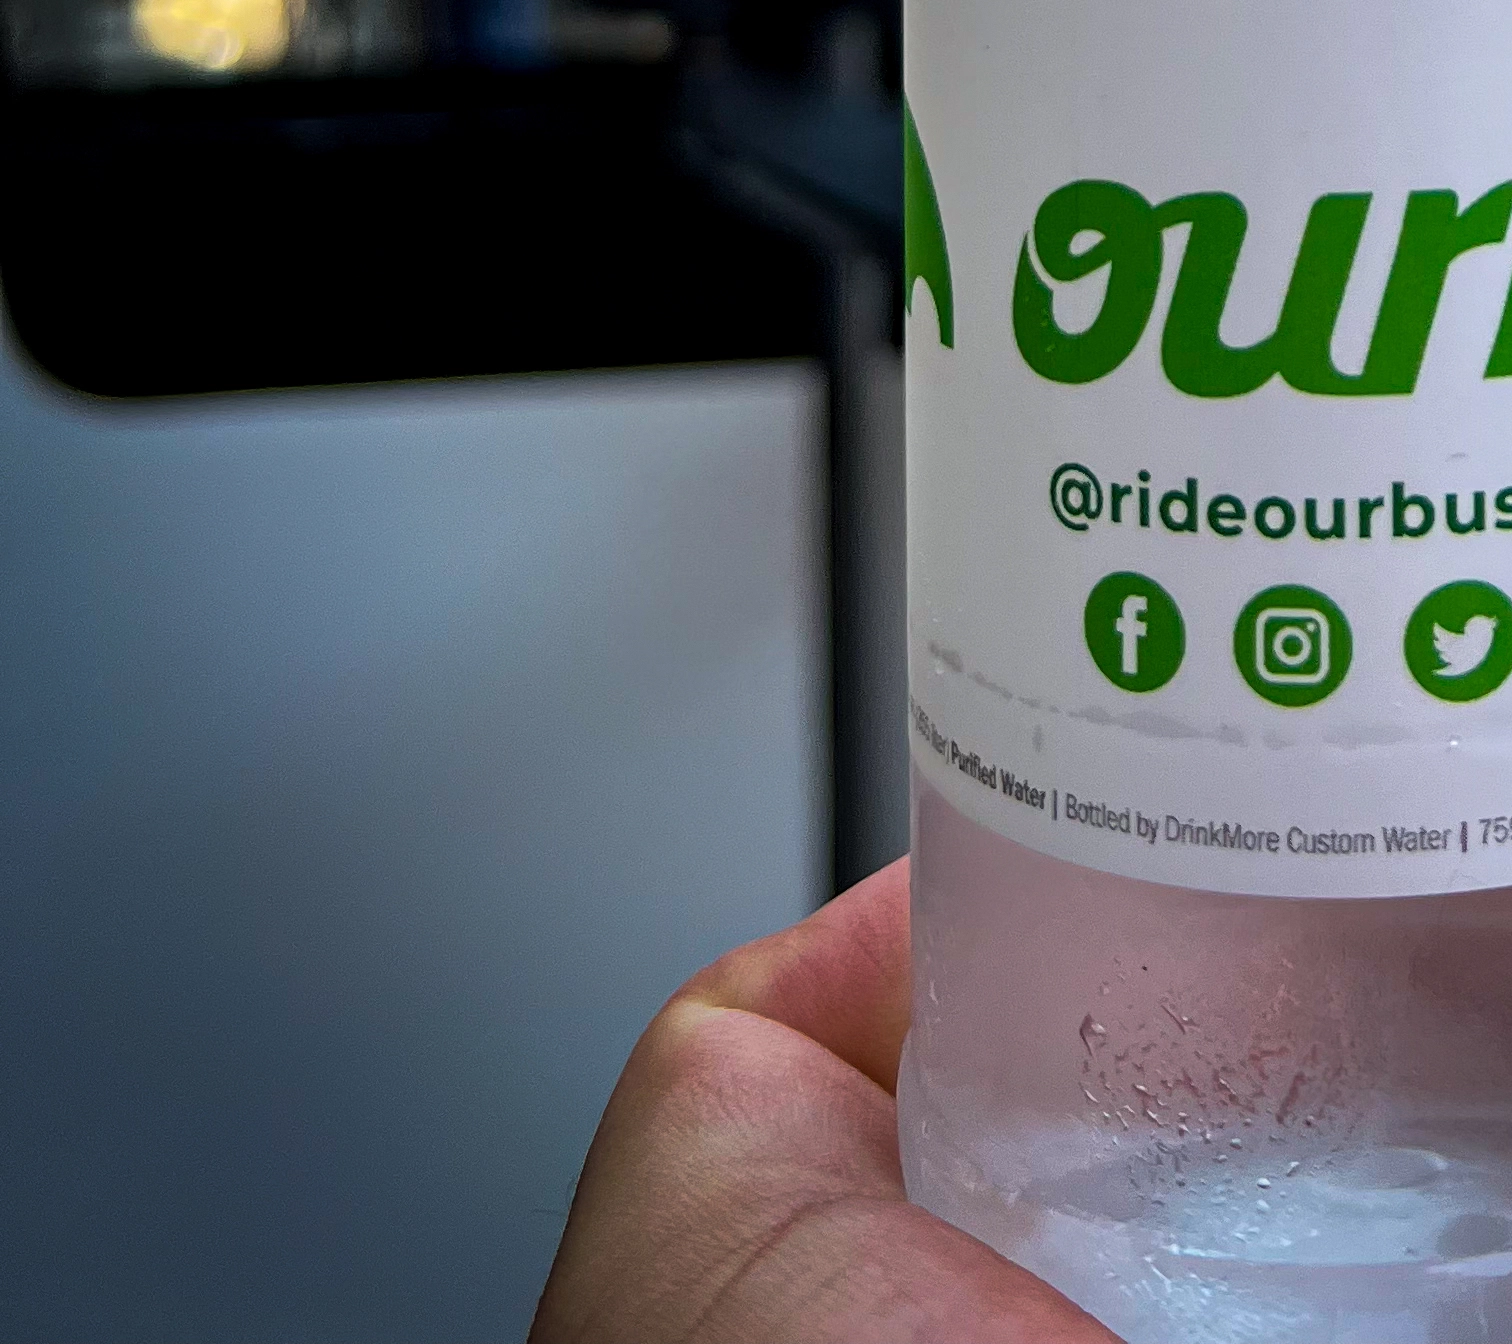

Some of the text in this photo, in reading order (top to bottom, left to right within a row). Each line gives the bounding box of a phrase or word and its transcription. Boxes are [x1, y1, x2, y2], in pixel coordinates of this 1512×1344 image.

[951, 738, 997, 790] Purified
[1000, 767, 1046, 810] Water
[1066, 792, 1131, 834] Bottled
[1136, 811, 1159, 845] by
[1165, 814, 1280, 853] DrinkMore
[1286, 825, 1375, 854] Custom
[1381, 824, 1451, 853] Water
